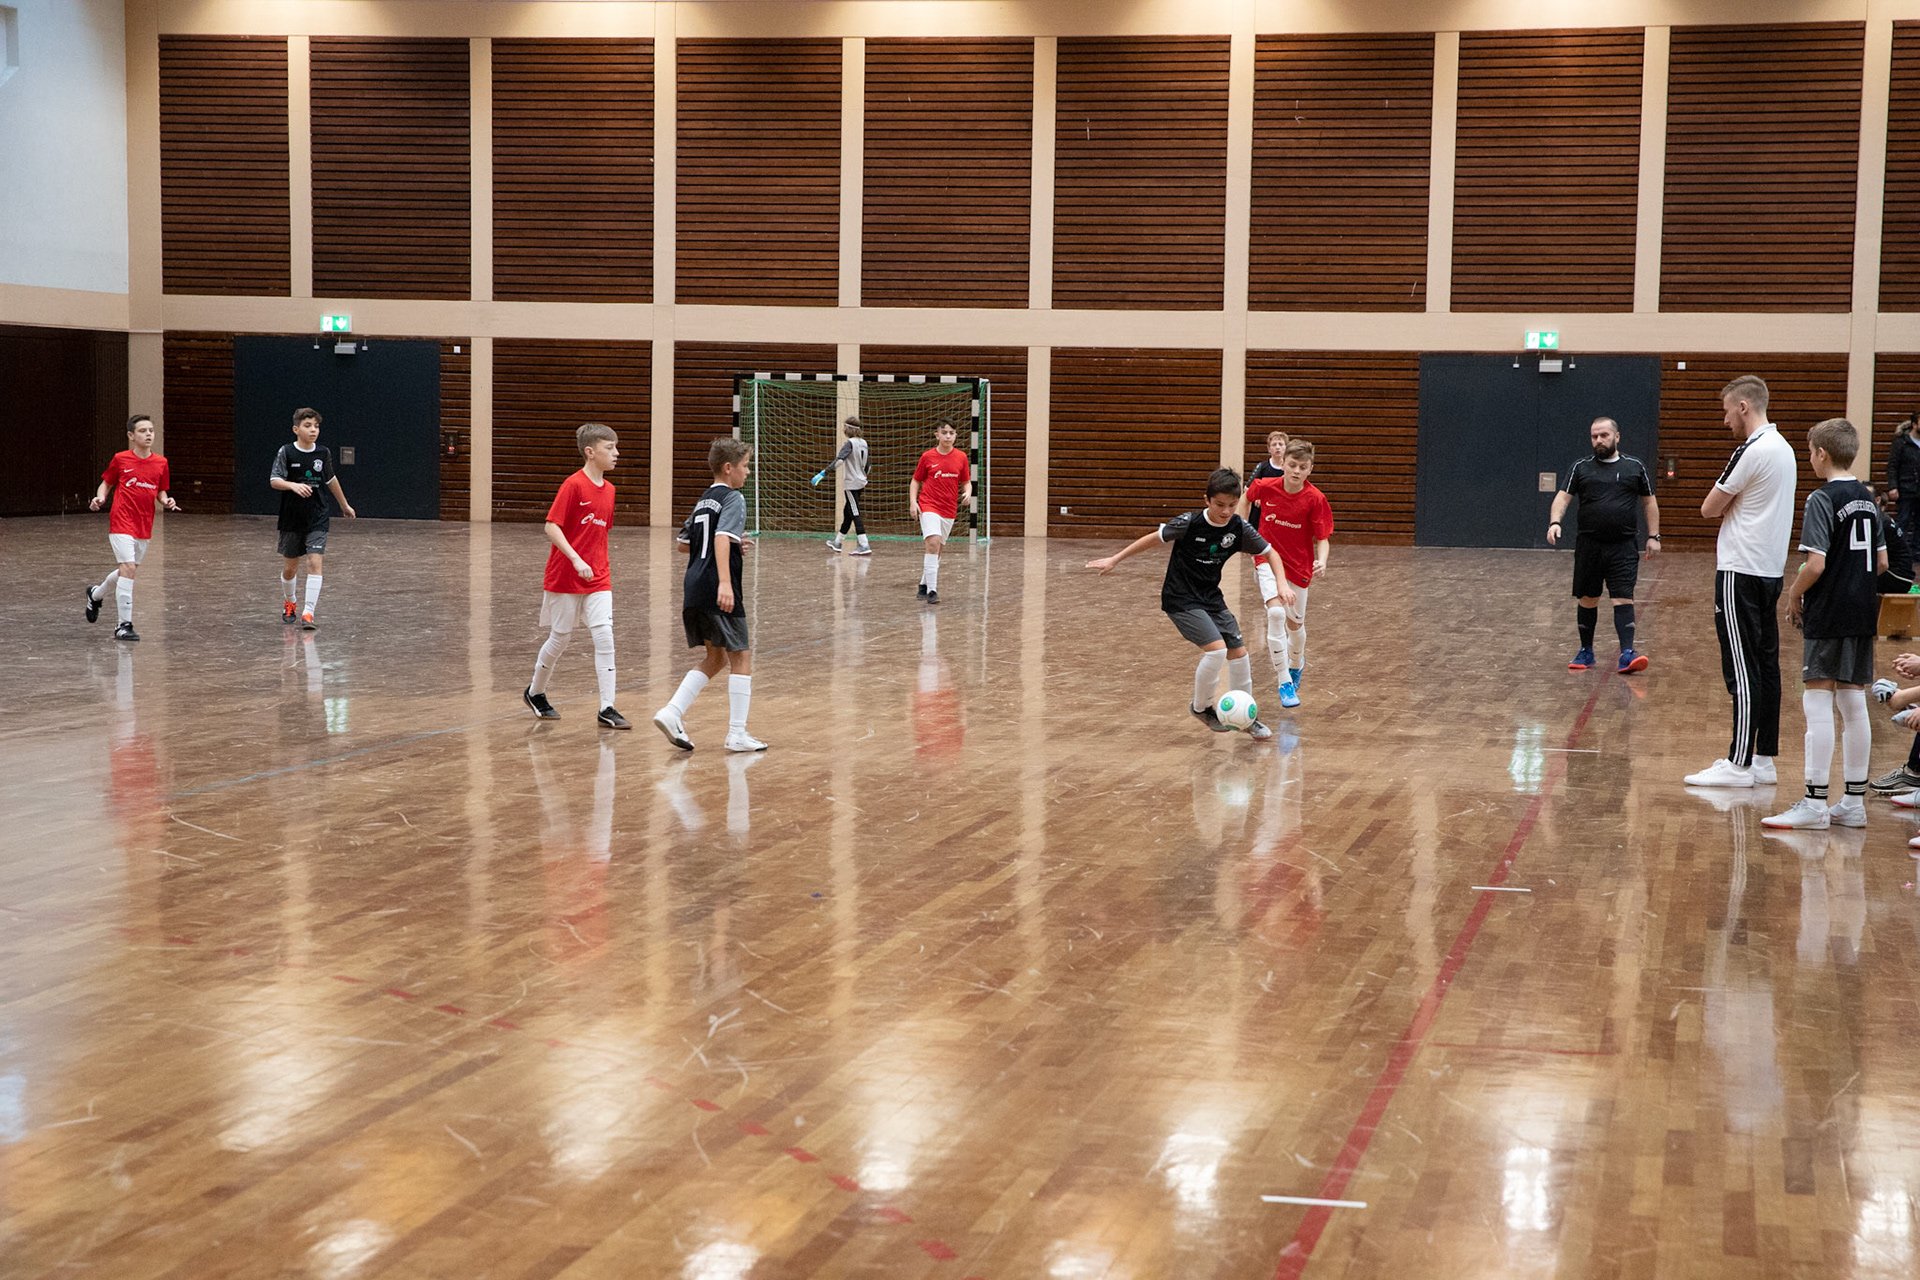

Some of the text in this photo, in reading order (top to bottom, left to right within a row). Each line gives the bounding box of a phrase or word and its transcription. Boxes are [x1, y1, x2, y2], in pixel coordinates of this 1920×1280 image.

[694, 513, 710, 559] 7
[1274, 519, 1302, 529] mainova
[1849, 518, 1873, 572] 4
